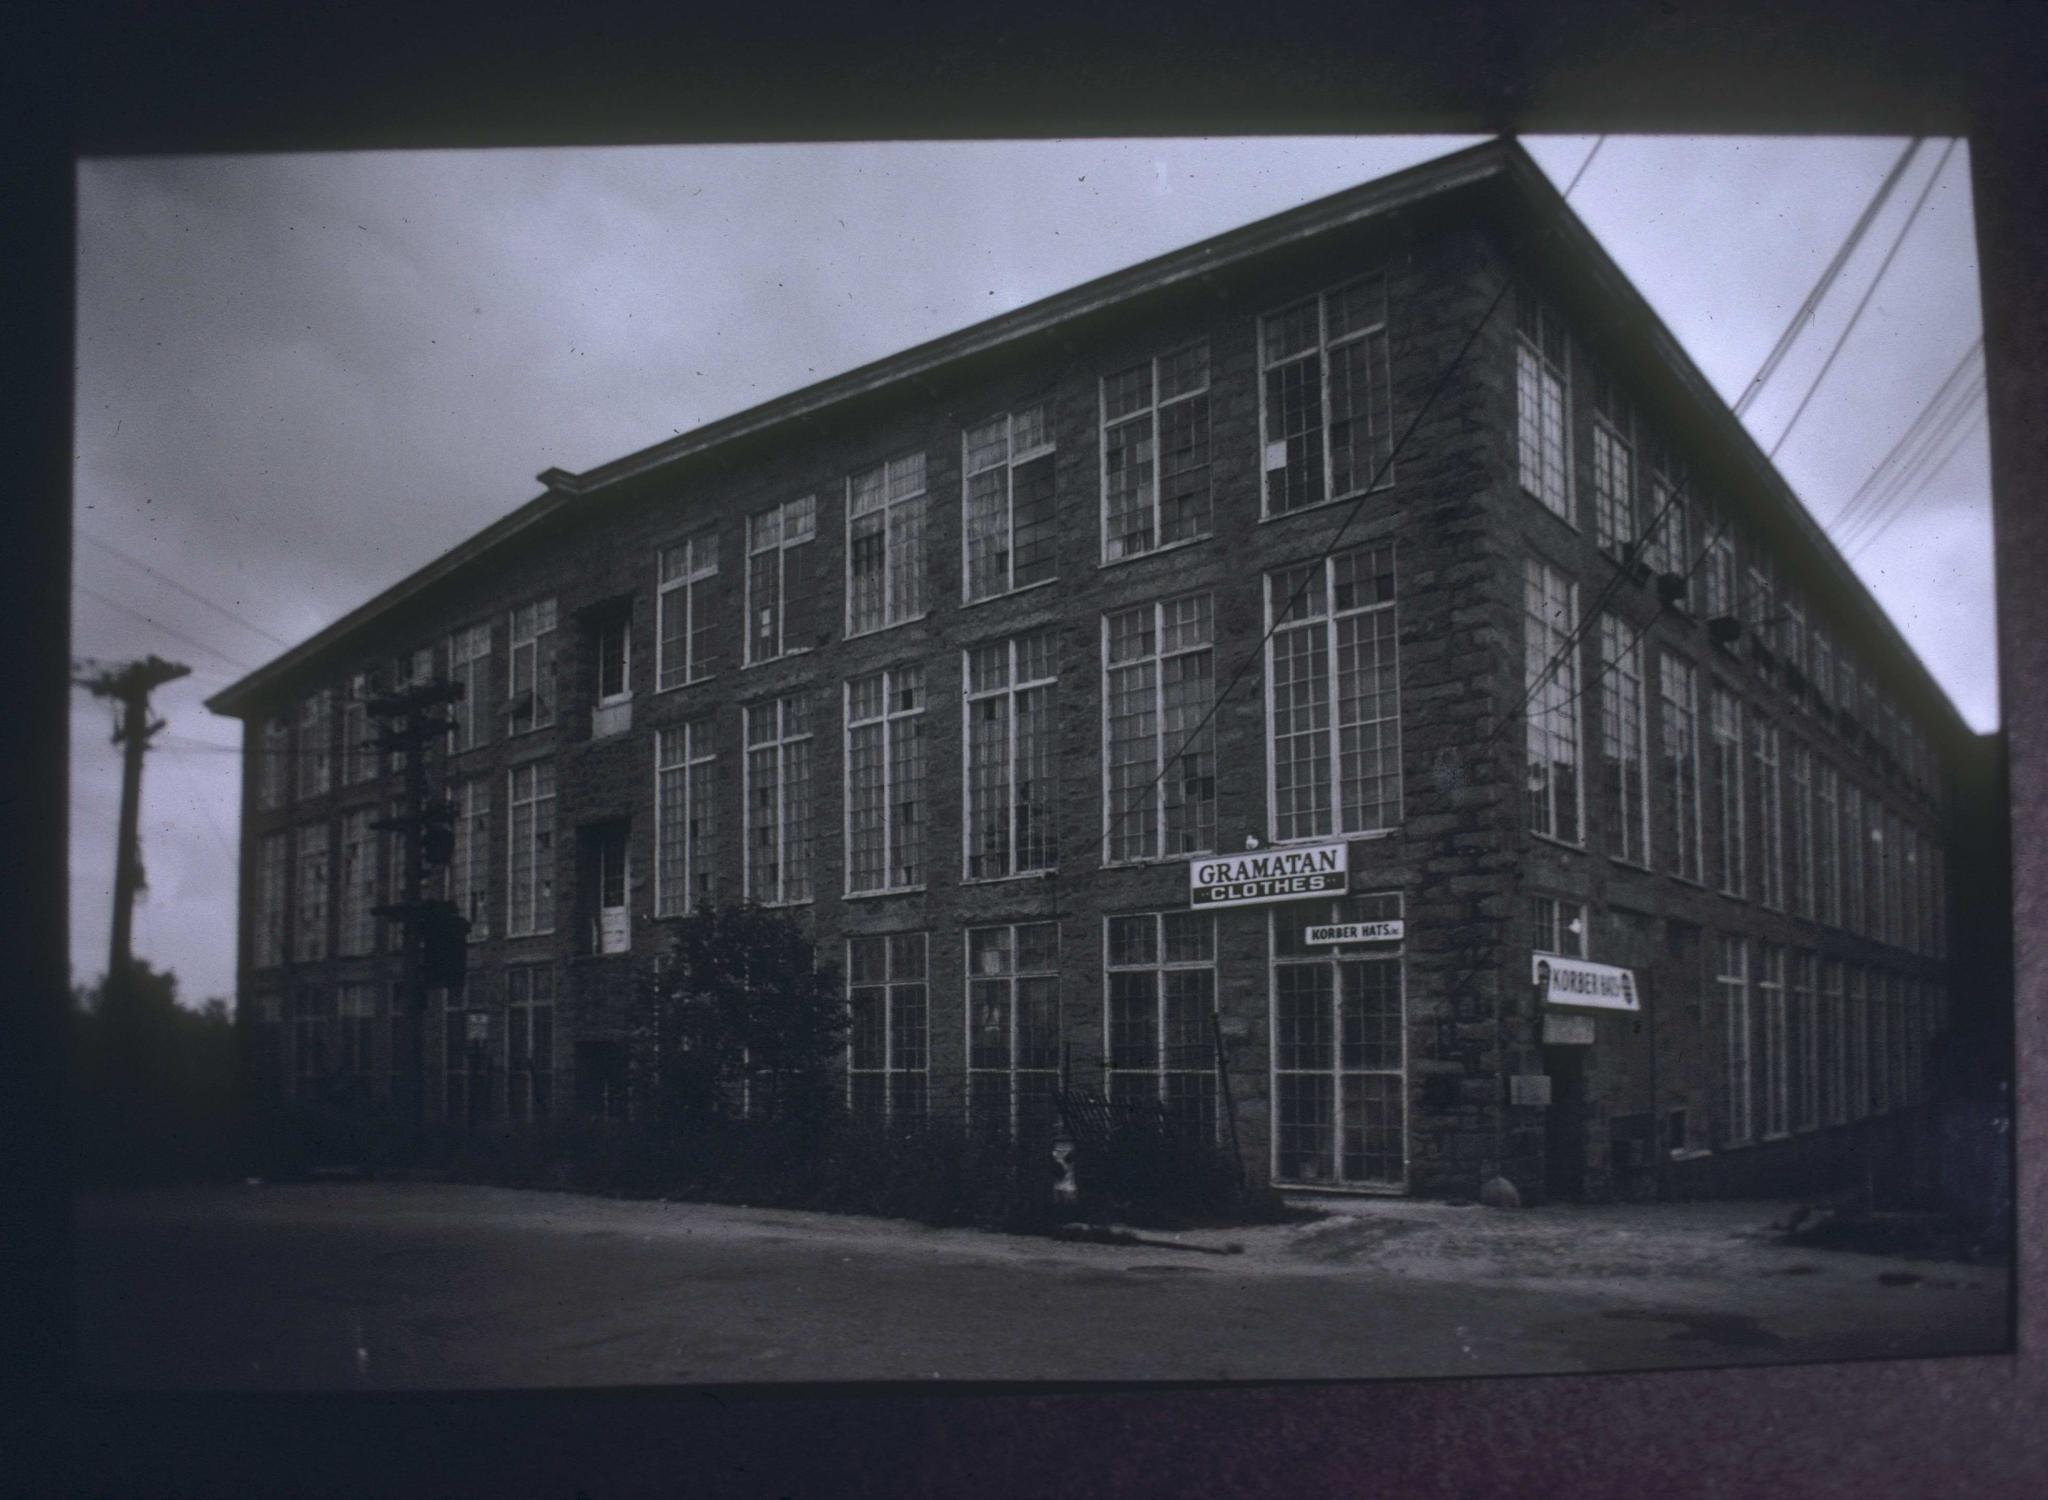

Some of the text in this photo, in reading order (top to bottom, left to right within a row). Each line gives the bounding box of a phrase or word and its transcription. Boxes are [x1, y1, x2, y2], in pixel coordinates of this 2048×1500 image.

[1199, 850, 1337, 885] GRAMATAN
[1211, 876, 1325, 900] CLOTHES
[1312, 926, 1357, 940] KORBER
